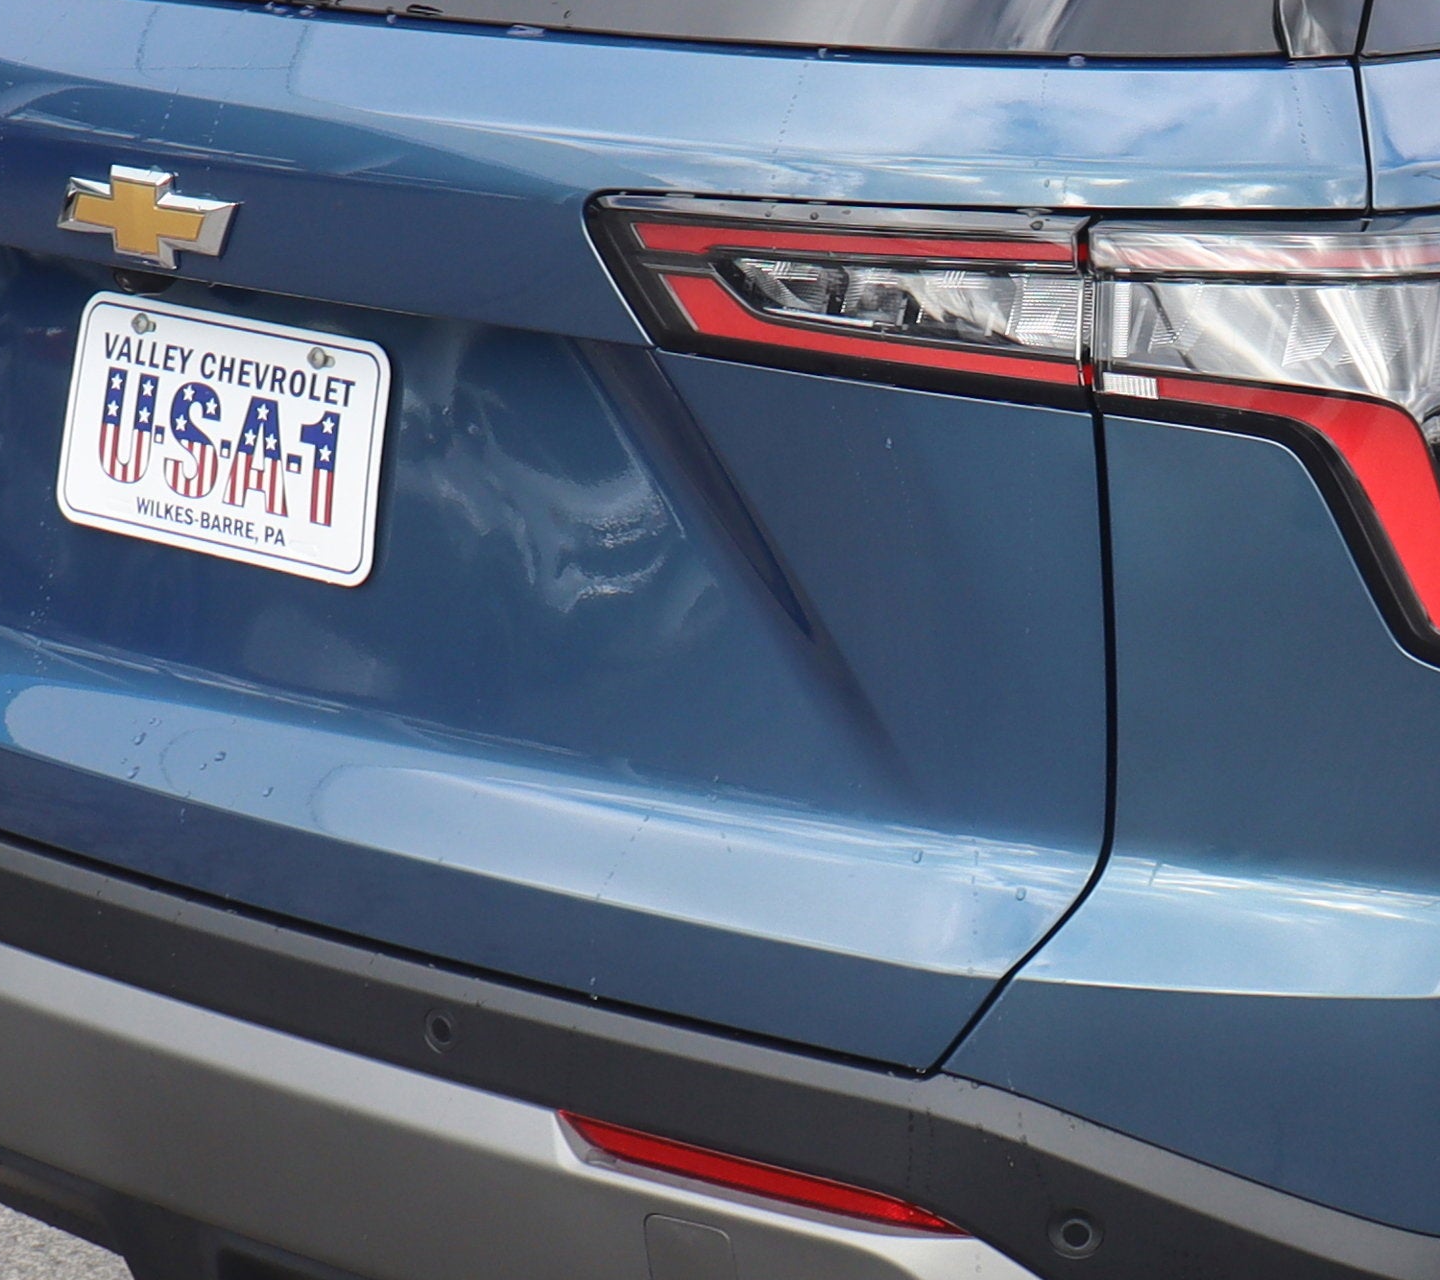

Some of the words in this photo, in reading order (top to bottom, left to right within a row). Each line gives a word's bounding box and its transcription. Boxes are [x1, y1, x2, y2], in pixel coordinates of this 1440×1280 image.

[104, 332, 194, 375] VALLEY
[200, 352, 356, 407] CHEVROLET
[136, 496, 259, 544] WILKES-BARRE,
[264, 525, 286, 547] PA
